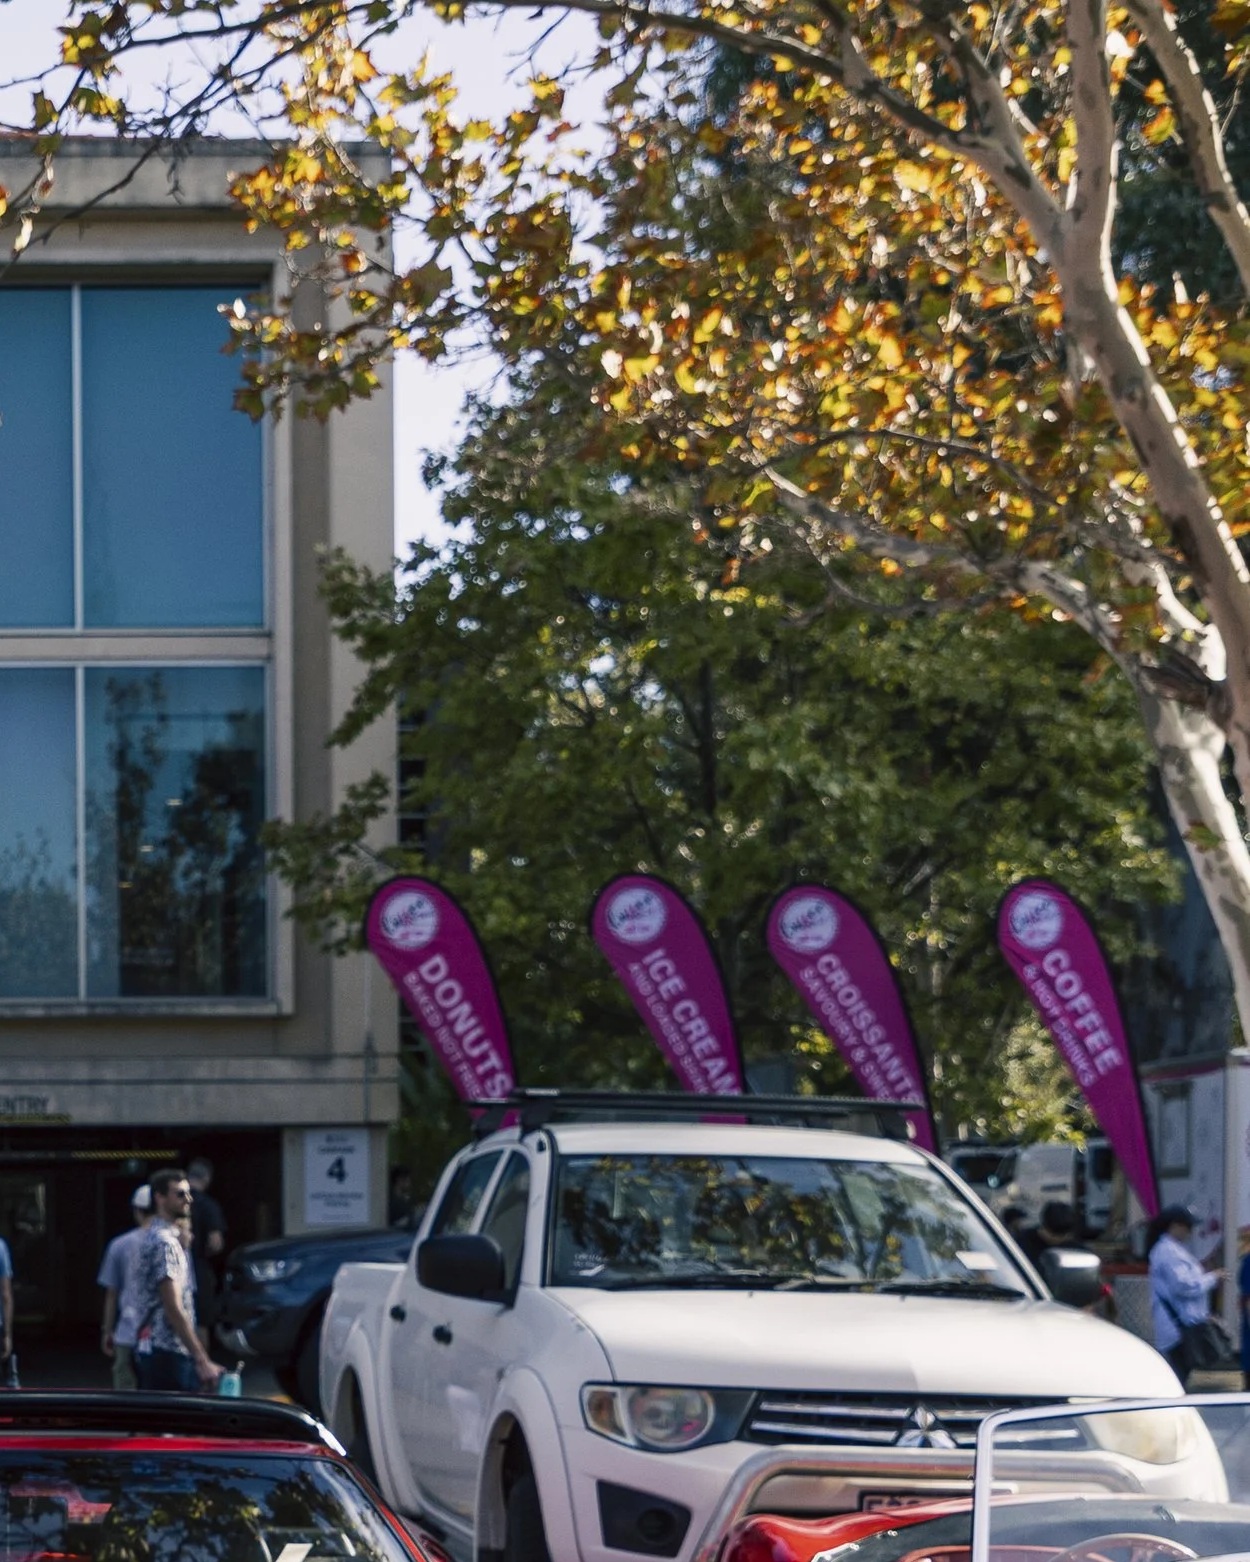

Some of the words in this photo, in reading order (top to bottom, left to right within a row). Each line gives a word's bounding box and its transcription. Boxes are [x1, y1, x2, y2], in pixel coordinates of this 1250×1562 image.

[642, 948, 686, 1001] ICE
[800, 966, 861, 1047] SAVOURY
[1042, 948, 1124, 1075] COFFEE
[403, 970, 444, 1028] BAKED
[434, 1025, 464, 1062] NOT
[455, 1061, 485, 1100] FRIE
[419, 953, 514, 1099] DONUTS
[1051, 1016, 1097, 1087] DRINKS
[327, 1156, 347, 1183] 4
